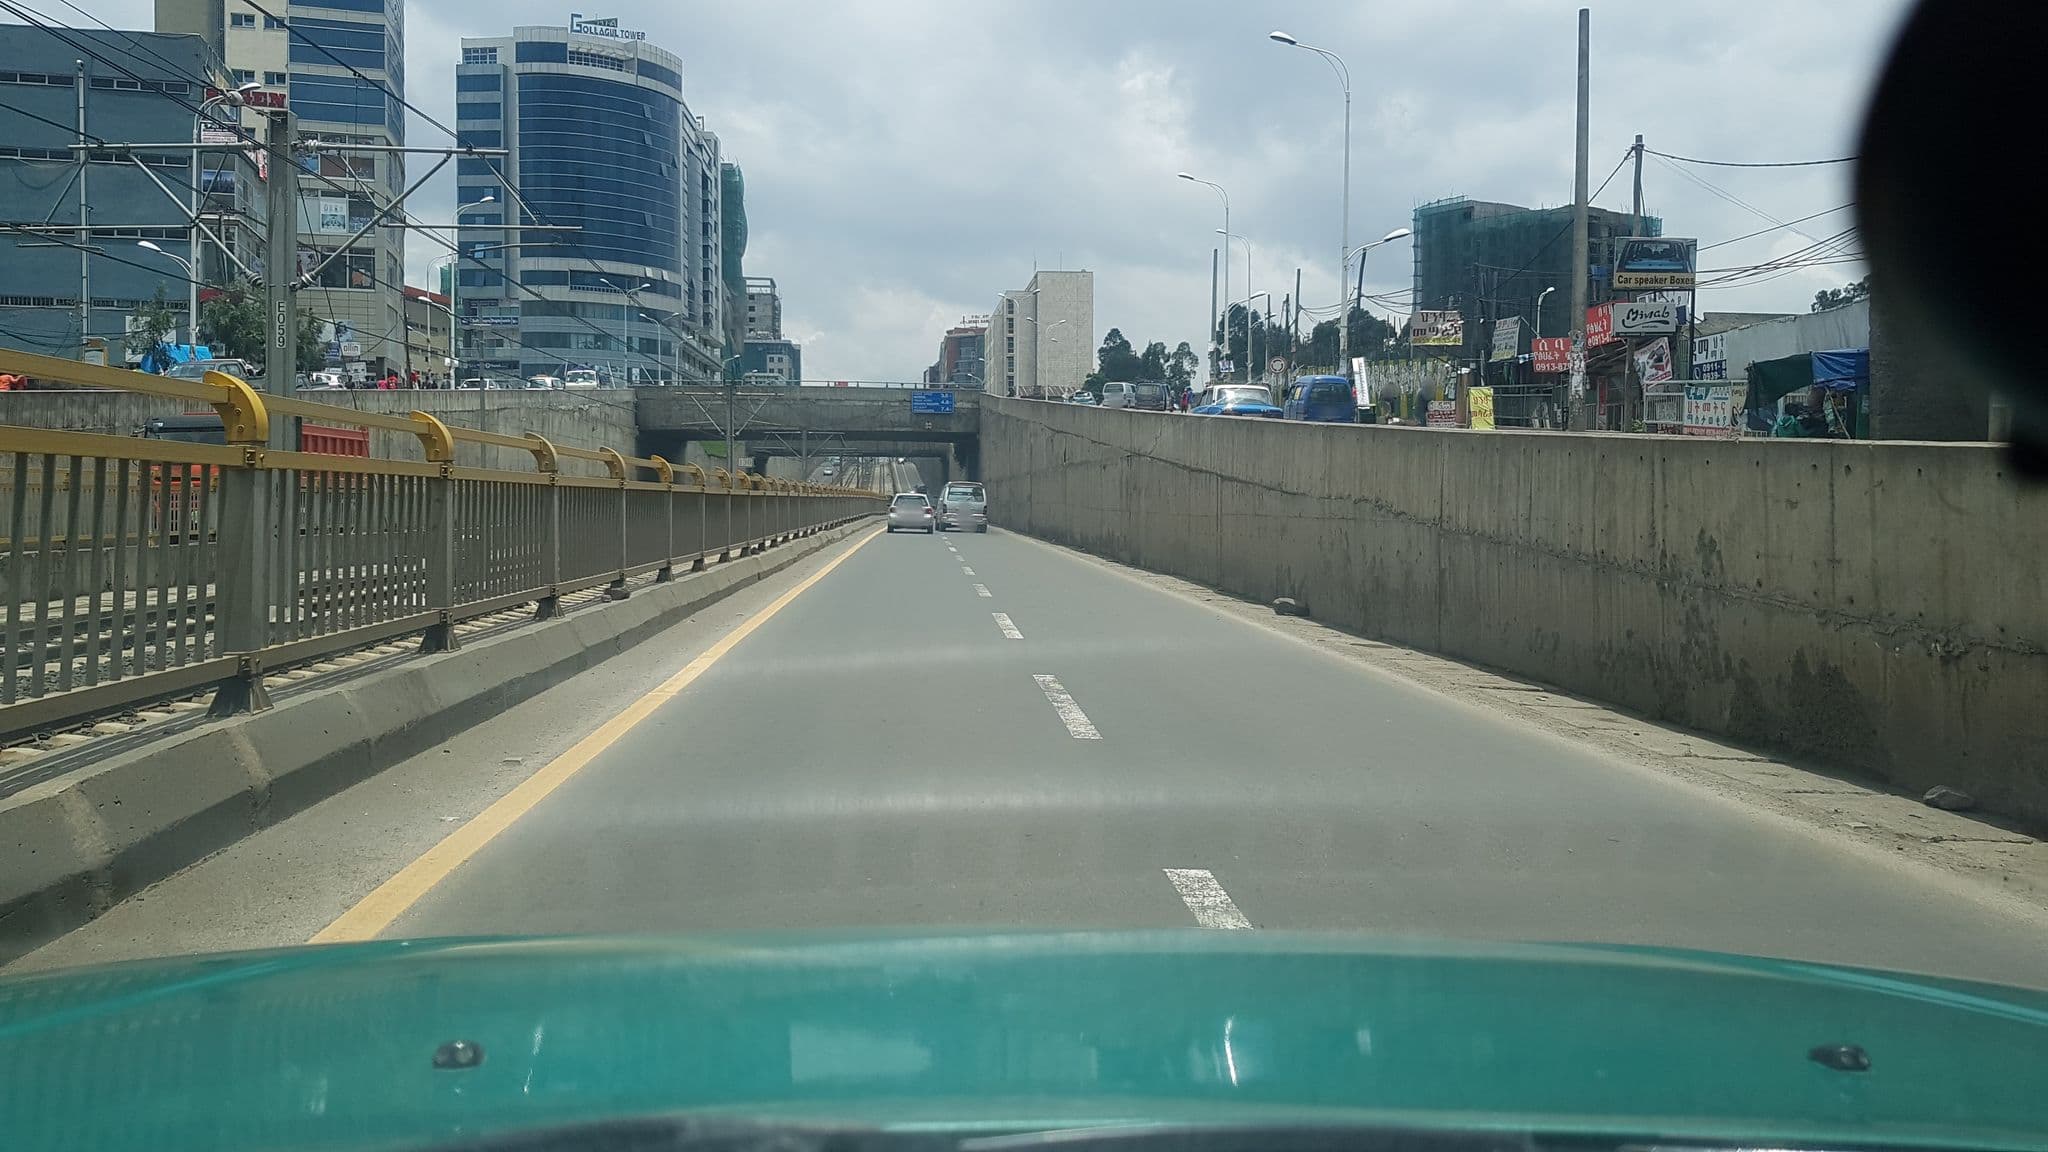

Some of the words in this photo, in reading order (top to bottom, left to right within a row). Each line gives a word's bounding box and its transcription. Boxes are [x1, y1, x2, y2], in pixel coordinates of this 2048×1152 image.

[620, 29, 646, 40] TOWER
[1617, 275, 1632, 285] Car
[1634, 275, 1668, 286] speaker
[1669, 275, 1696, 285] Boxes
[277, 301, 285, 348] E059
